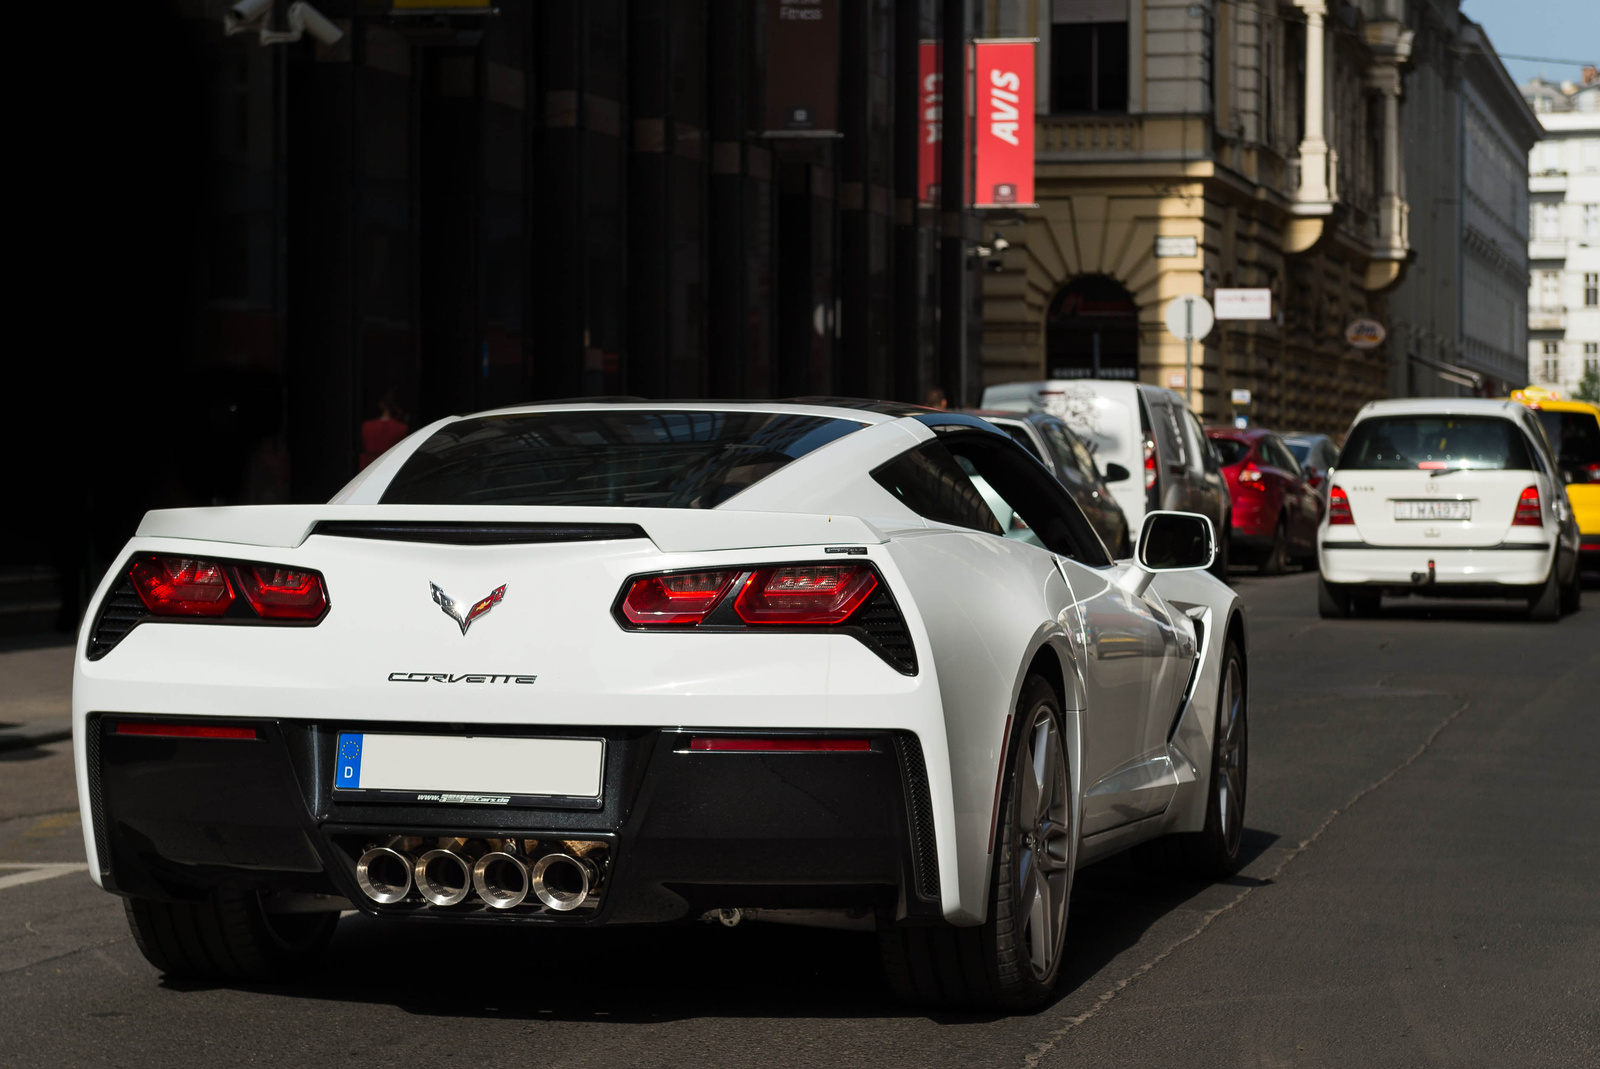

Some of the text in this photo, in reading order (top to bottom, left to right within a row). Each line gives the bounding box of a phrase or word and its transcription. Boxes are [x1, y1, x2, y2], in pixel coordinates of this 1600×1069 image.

[779, 6, 823, 20] Fitness
[990, 69, 1020, 146] AVIS
[388, 672, 538, 685] CORVETTE
[344, 766, 353, 778] D
